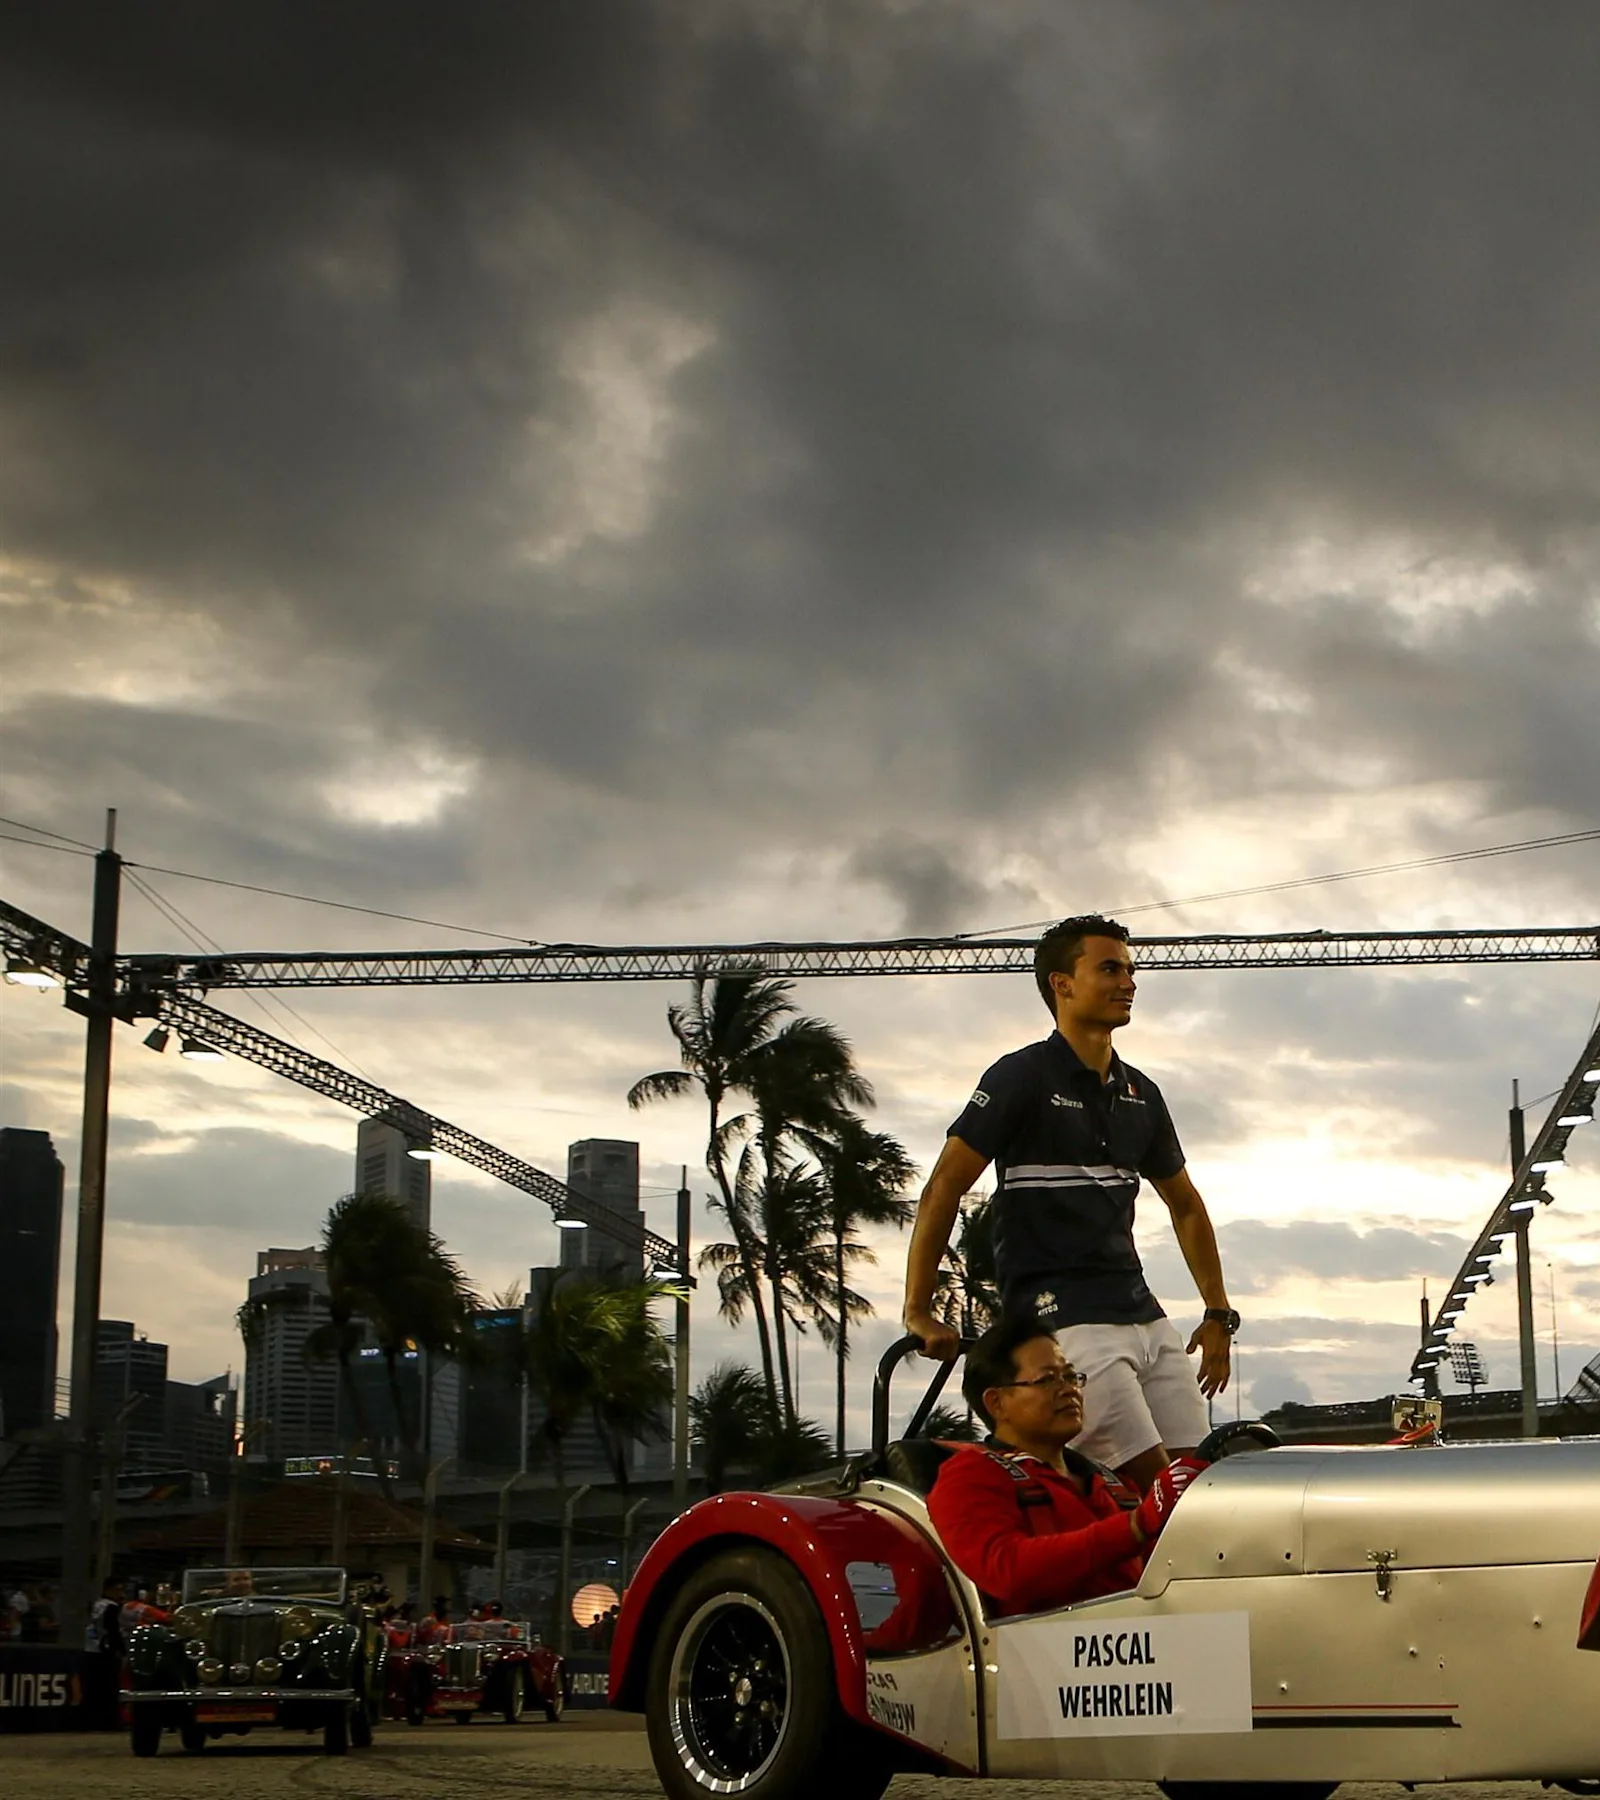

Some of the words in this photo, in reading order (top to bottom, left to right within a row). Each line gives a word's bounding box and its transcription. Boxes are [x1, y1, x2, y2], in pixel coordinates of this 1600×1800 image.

[1073, 1632, 1155, 1667] PASCAL
[0, 1673, 68, 1707] LINES
[1058, 1683, 1173, 1718] WEHRLEIN
